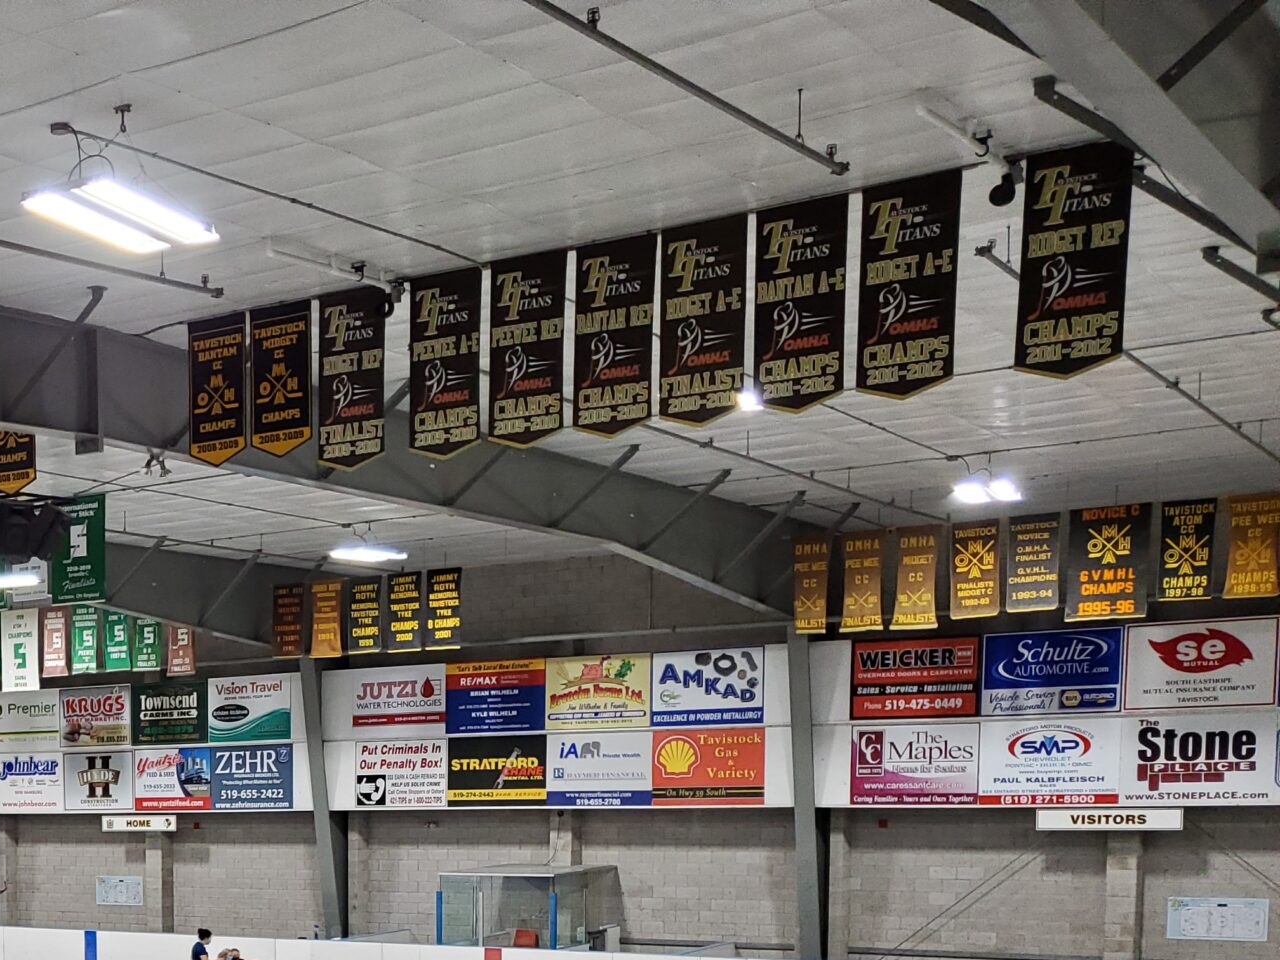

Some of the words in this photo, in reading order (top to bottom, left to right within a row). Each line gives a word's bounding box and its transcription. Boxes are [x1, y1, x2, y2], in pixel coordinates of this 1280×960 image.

[1028, 225, 1086, 258] MIDGET
[1091, 220, 1125, 246] REP
[924, 249, 953, 276] A-E
[1052, 292, 1108, 310] OMHA
[889, 317, 940, 335] OMHA
[1024, 312, 1118, 346] CHAMPS
[198, 346, 237, 361] BANTAM
[864, 336, 950, 368] CHAMPS
[1026, 338, 1112, 364] 2011-2012
[760, 352, 839, 383] CHAMPS
[867, 361, 944, 385] 2011-2012
[661, 367, 744, 398] FINALIST
[578, 382, 649, 409] CHAMPS
[259, 430, 304, 445] 2008-2009
[1083, 506, 1126, 521] NOVICE
[1131, 505, 1140, 515] C
[1165, 503, 1216, 516] TAVISTOCK
[1173, 515, 1203, 526] ATOM
[391, 576, 416, 584] JIMMY
[957, 581, 994, 589] FINALISTS
[1009, 574, 1057, 584] CHAMPIONS
[1163, 576, 1207, 588] CHAMPS
[1012, 590, 1052, 600] 1993-94
[1081, 582, 1134, 595] CHAMPS
[1166, 588, 1203, 597] 1997-98
[1078, 600, 1135, 615] 1995-96
[435, 630, 451, 638] 2001
[1013, 640, 1096, 663] Schultz
[1176, 639, 1226, 661] se
[858, 647, 956, 669] WEICKER
[216, 682, 247, 696] Vision
[249, 680, 282, 693] Travel
[460, 676, 497, 686] RE/MAX
[659, 664, 756, 702] AMKAD
[886, 685, 918, 693] Service
[924, 683, 973, 692] Installation
[357, 680, 418, 700] JUTZI
[990, 691, 1020, 704] Vehicle
[1024, 690, 1056, 700] Service
[1176, 686, 1217, 694] INSURANCE
[64, 694, 125, 715] KRUGS
[140, 692, 197, 710] Townsend
[357, 702, 382, 710] WATER
[382, 699, 442, 708] TECHNOLOGIES
[885, 698, 962, 710] 519-475-0449
[8, 702, 56, 715] Premier
[653, 714, 688, 723] EXCELLENCE
[696, 713, 721, 721] POWDER
[722, 711, 762, 720] METALLURGY
[697, 734, 762, 745] Tavistock
[912, 731, 942, 744] The
[1138, 727, 1256, 762] Stone
[361, 745, 378, 755] Put
[381, 743, 428, 755] Criminals
[432, 743, 441, 753] In
[715, 749, 738, 758] Gas
[888, 740, 974, 765] Maples
[1020, 740, 1079, 756] SMP
[0, 756, 58, 780] johnbear
[215, 751, 278, 774] ZEHR
[360, 760, 377, 769] Our
[380, 759, 417, 771] Penalty
[421, 757, 442, 768] Box!
[451, 757, 539, 771] STRATFORD
[1154, 762, 1251, 772] PLACE
[82, 770, 115, 782] HYDE
[503, 766, 544, 776] CRANE
[707, 767, 757, 781] Variety
[221, 789, 284, 799] 519-655-2422
[666, 788, 677, 796] On
[679, 789, 695, 798] Hwy
[696, 790, 705, 798] 59
[706, 788, 726, 796] South
[1001, 796, 1032, 804] (519)
[1036, 795, 1095, 803] 271-5900
[1125, 792, 1269, 801] www.STONEPLACE.com
[1070, 814, 1147, 825] VISITORS
